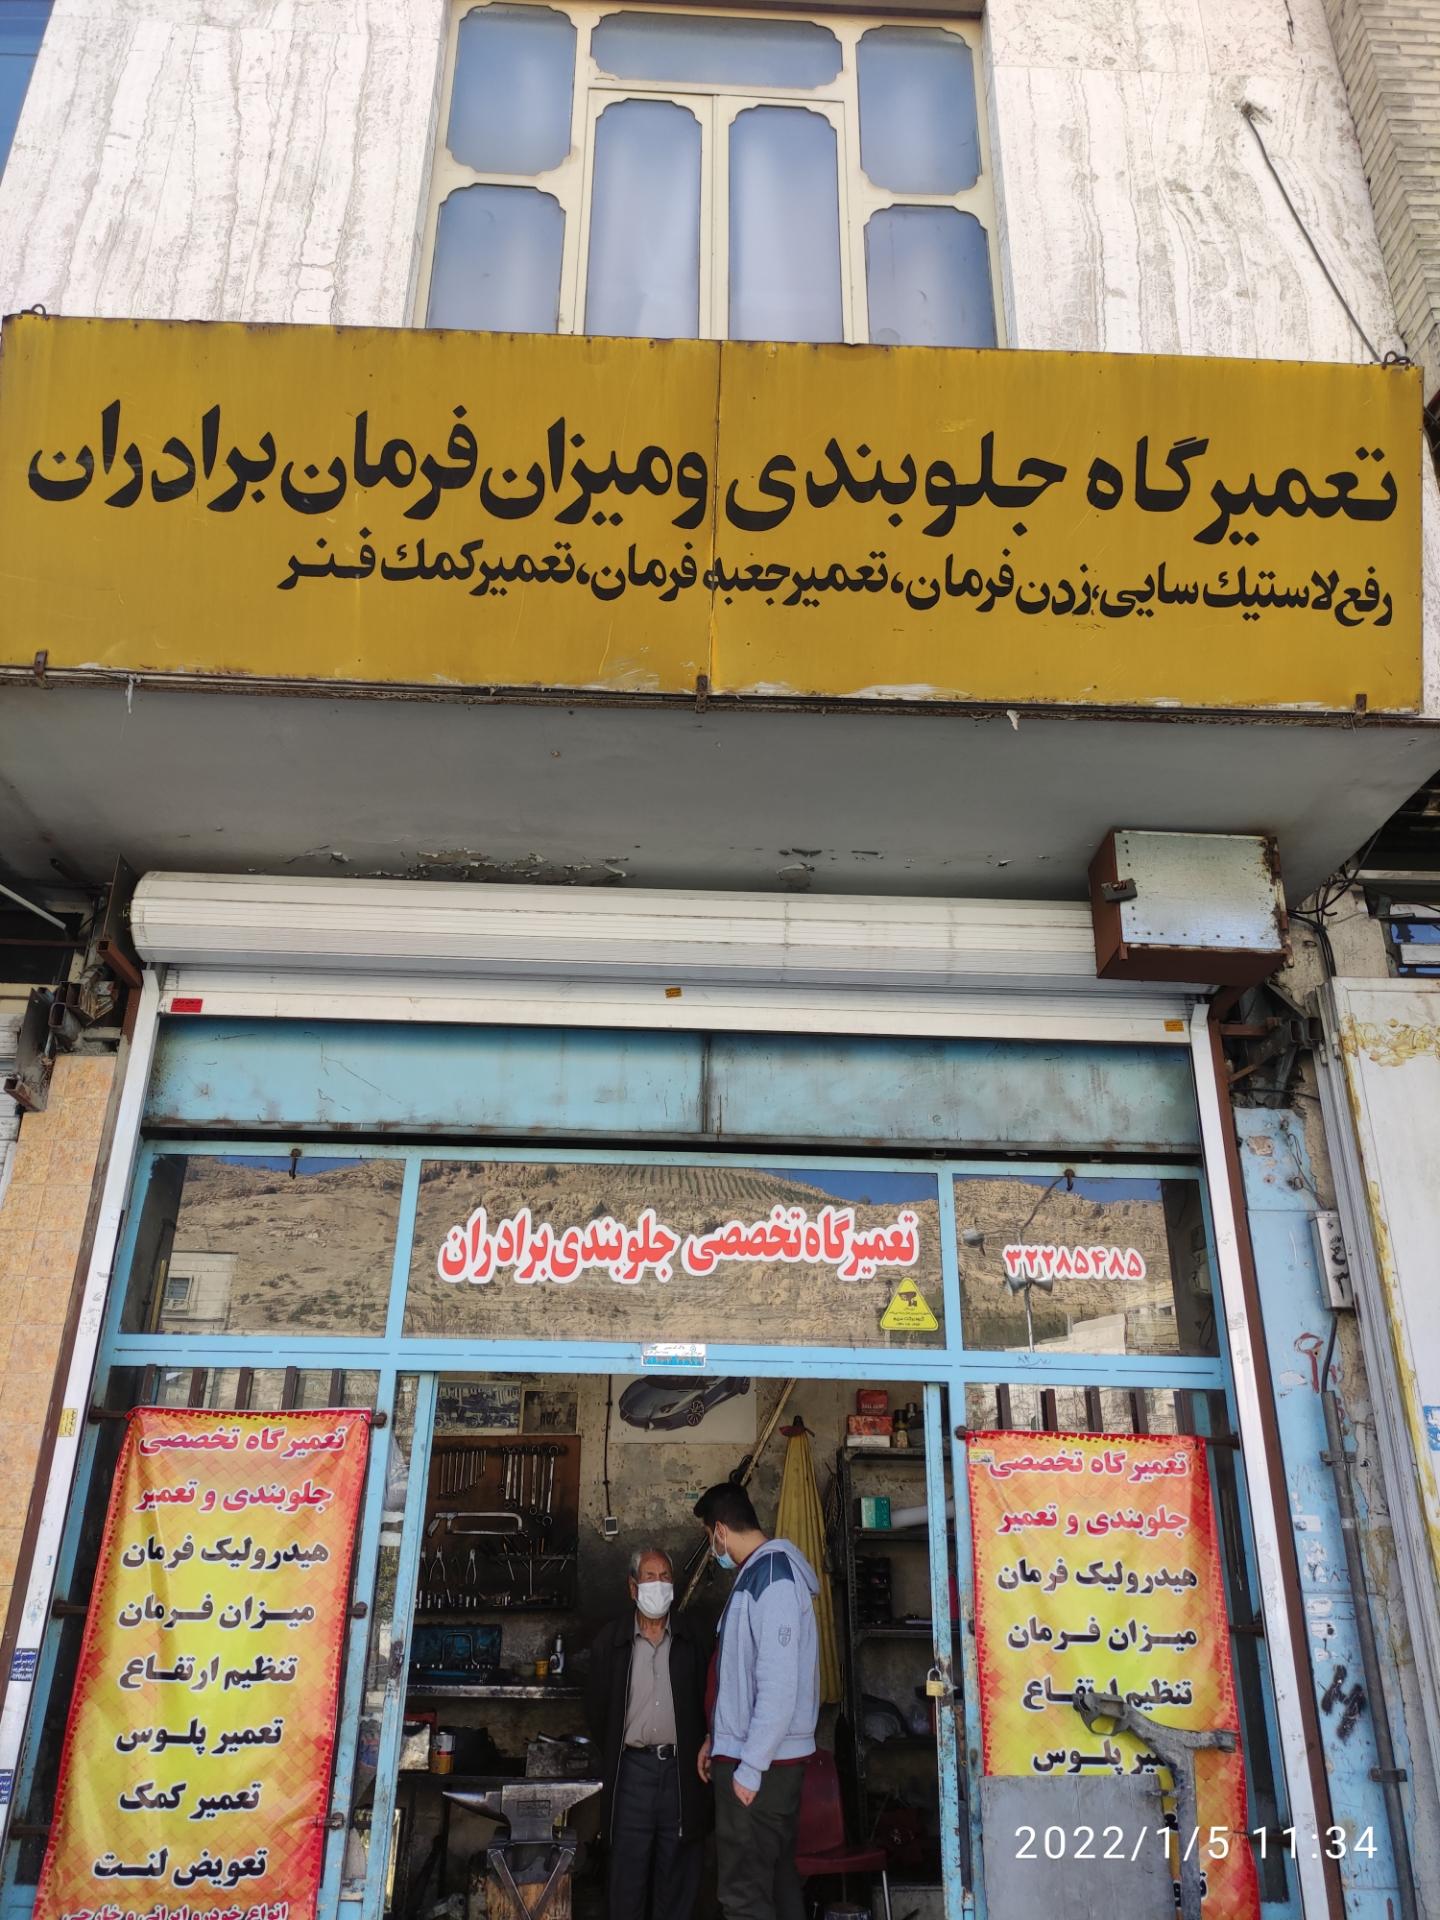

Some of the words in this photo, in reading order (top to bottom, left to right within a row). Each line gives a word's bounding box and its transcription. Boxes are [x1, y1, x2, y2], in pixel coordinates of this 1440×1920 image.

[27, 399, 277, 513] برادران
[280, 404, 479, 521] فرمان
[276, 527, 376, 591] فنر
[469, 541, 576, 597] تعمیر
[1334, 566, 1393, 627] رفع
[438, 1206, 554, 1283] برادران
[684, 1205, 802, 1275] تخصصی
[1002, 1245, 1147, 1280] ۳۲۲۸۵۴۸۵
[139, 1427, 240, 1455] تخصصی
[989, 1450, 1084, 1477] تخصصی
[135, 1480, 198, 1511] تعمیر
[200, 1488, 217, 1511] و
[998, 1505, 1058, 1534] تعمیر
[1066, 1514, 1080, 1535] و
[121, 1535, 194, 1569] فرمان
[200, 1536, 329, 1569] هیدرولیک
[998, 1558, 1069, 1591] فرمان
[1075, 1561, 1198, 1594] هیدرولیک
[118, 1594, 214, 1629] فرمان
[218, 1596, 315, 1629] میزان
[1008, 1617, 1101, 1651] فرمان
[1107, 1619, 1198, 1652] میزان
[118, 1655, 220, 1691] ارتفاع
[223, 1656, 298, 1690] تنظیم
[1125, 1678, 1193, 1711] تنظیم
[116, 1718, 206, 1755] پلوس
[211, 1719, 284, 1754] تعمیر
[1032, 1739, 1123, 1775] پلوس
[119, 1782, 187, 1809] کمک
[189, 1783, 262, 1819] تعمیر
[94, 1848, 169, 1876] لنت
[173, 1849, 268, 1886] تعویض
